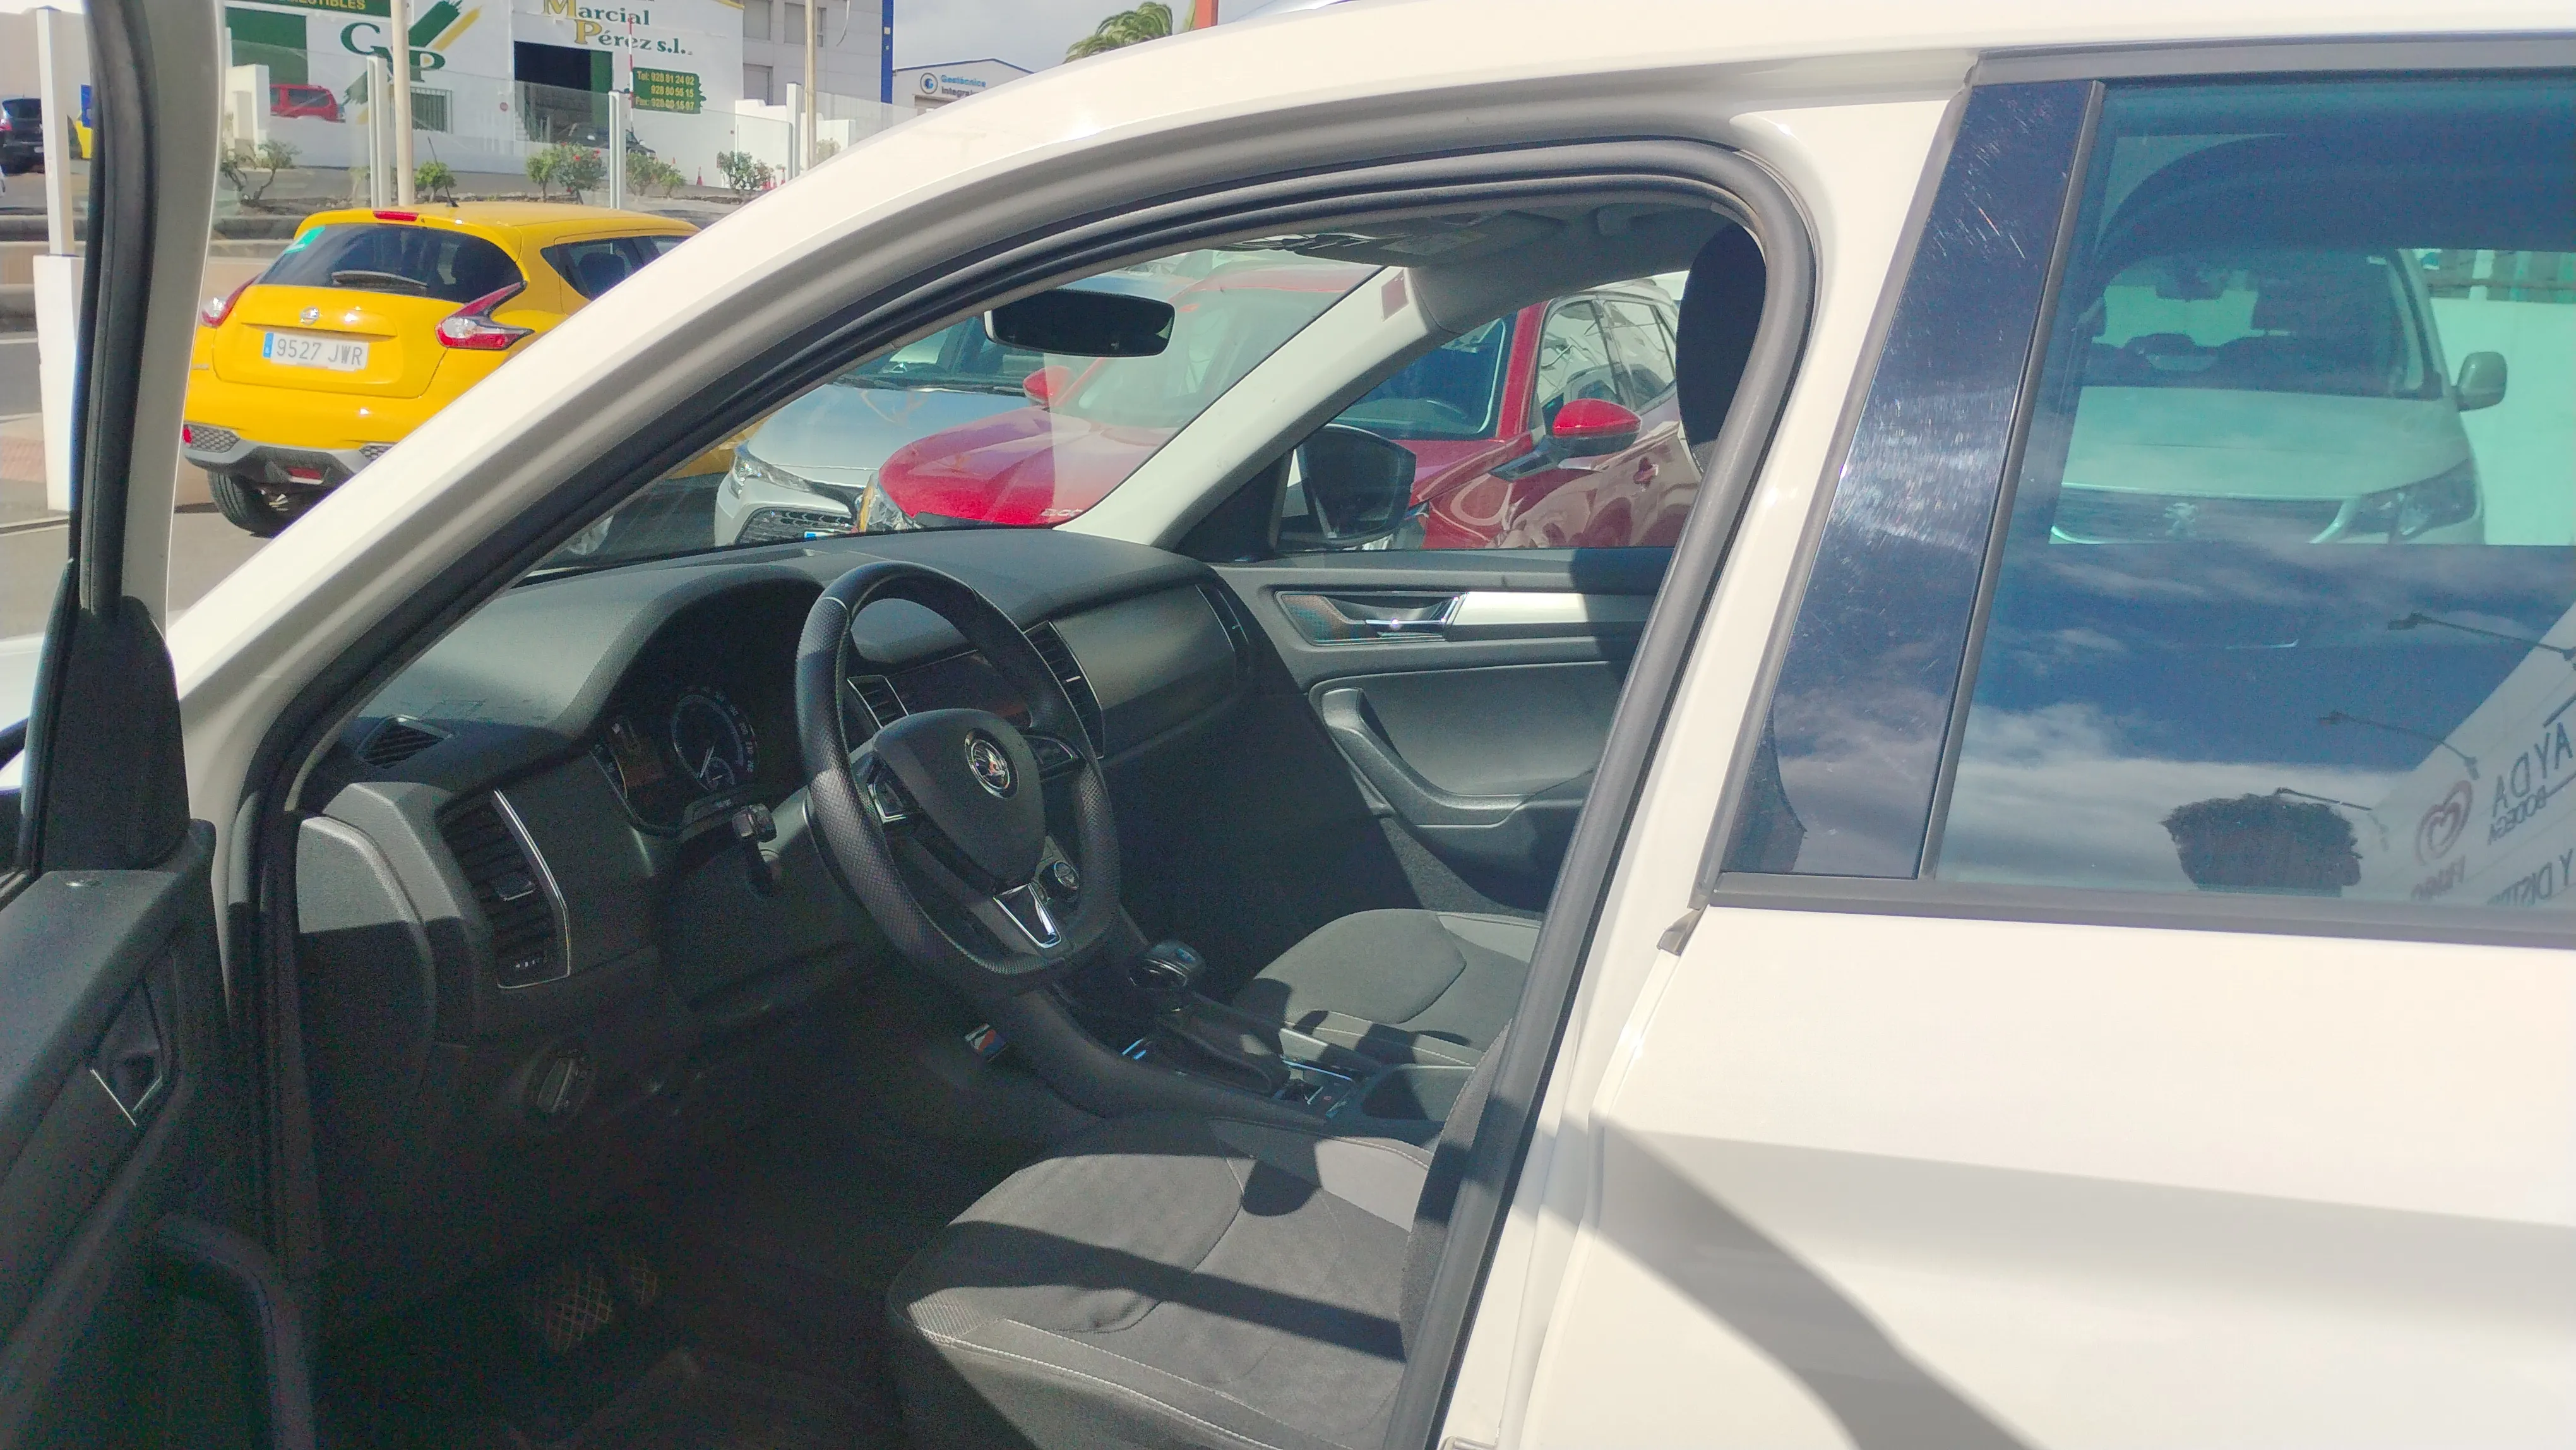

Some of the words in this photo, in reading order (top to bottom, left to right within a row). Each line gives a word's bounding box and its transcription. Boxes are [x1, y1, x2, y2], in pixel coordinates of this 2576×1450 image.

[542, 0, 650, 26] Marcial
[574, 19, 652, 51] Pérez
[277, 338, 322, 361] 9527
[328, 344, 363, 366] JWR
